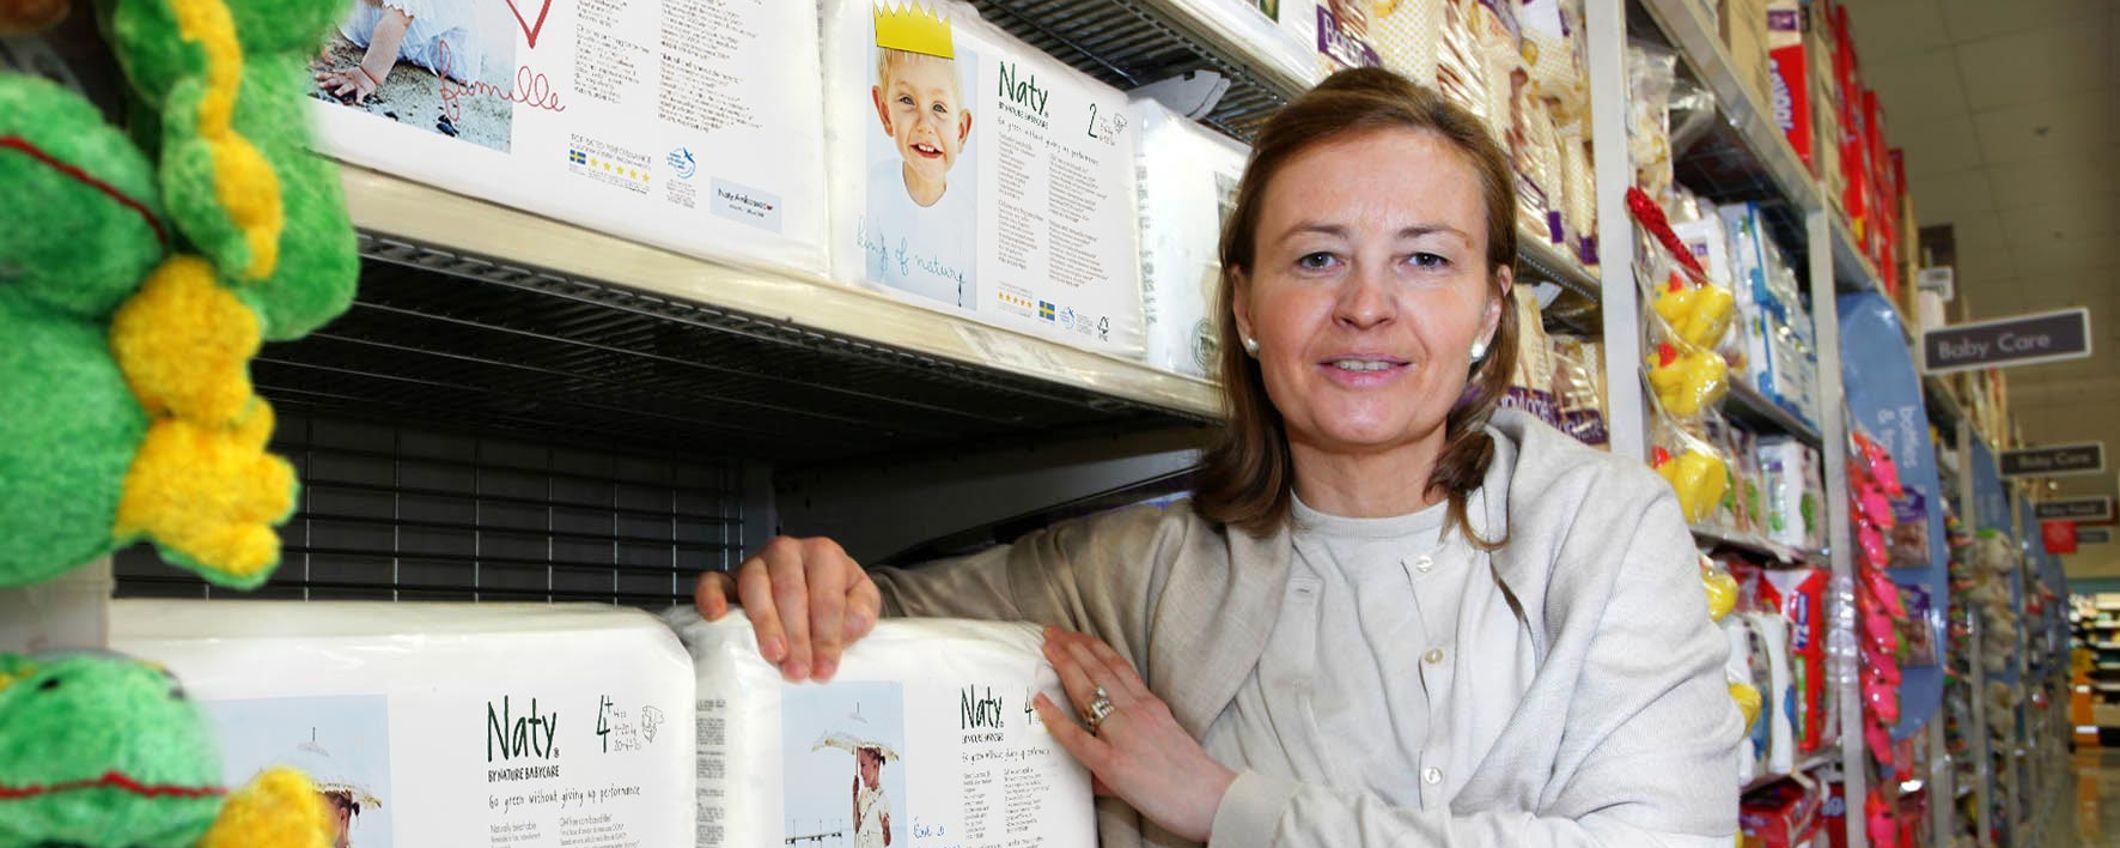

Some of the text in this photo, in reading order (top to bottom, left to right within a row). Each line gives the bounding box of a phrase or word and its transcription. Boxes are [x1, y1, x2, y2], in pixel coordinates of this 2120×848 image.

[439, 40, 566, 122] famille
[998, 60, 1048, 116] Naty
[895, 235, 910, 277] of
[1938, 333, 2051, 360] Baby Care
[487, 694, 557, 763] Naty
[959, 683, 1002, 730] Naty
[488, 765, 560, 782] BY NATURE BABYCARE
[489, 783, 641, 814] Go green without giving up performance
